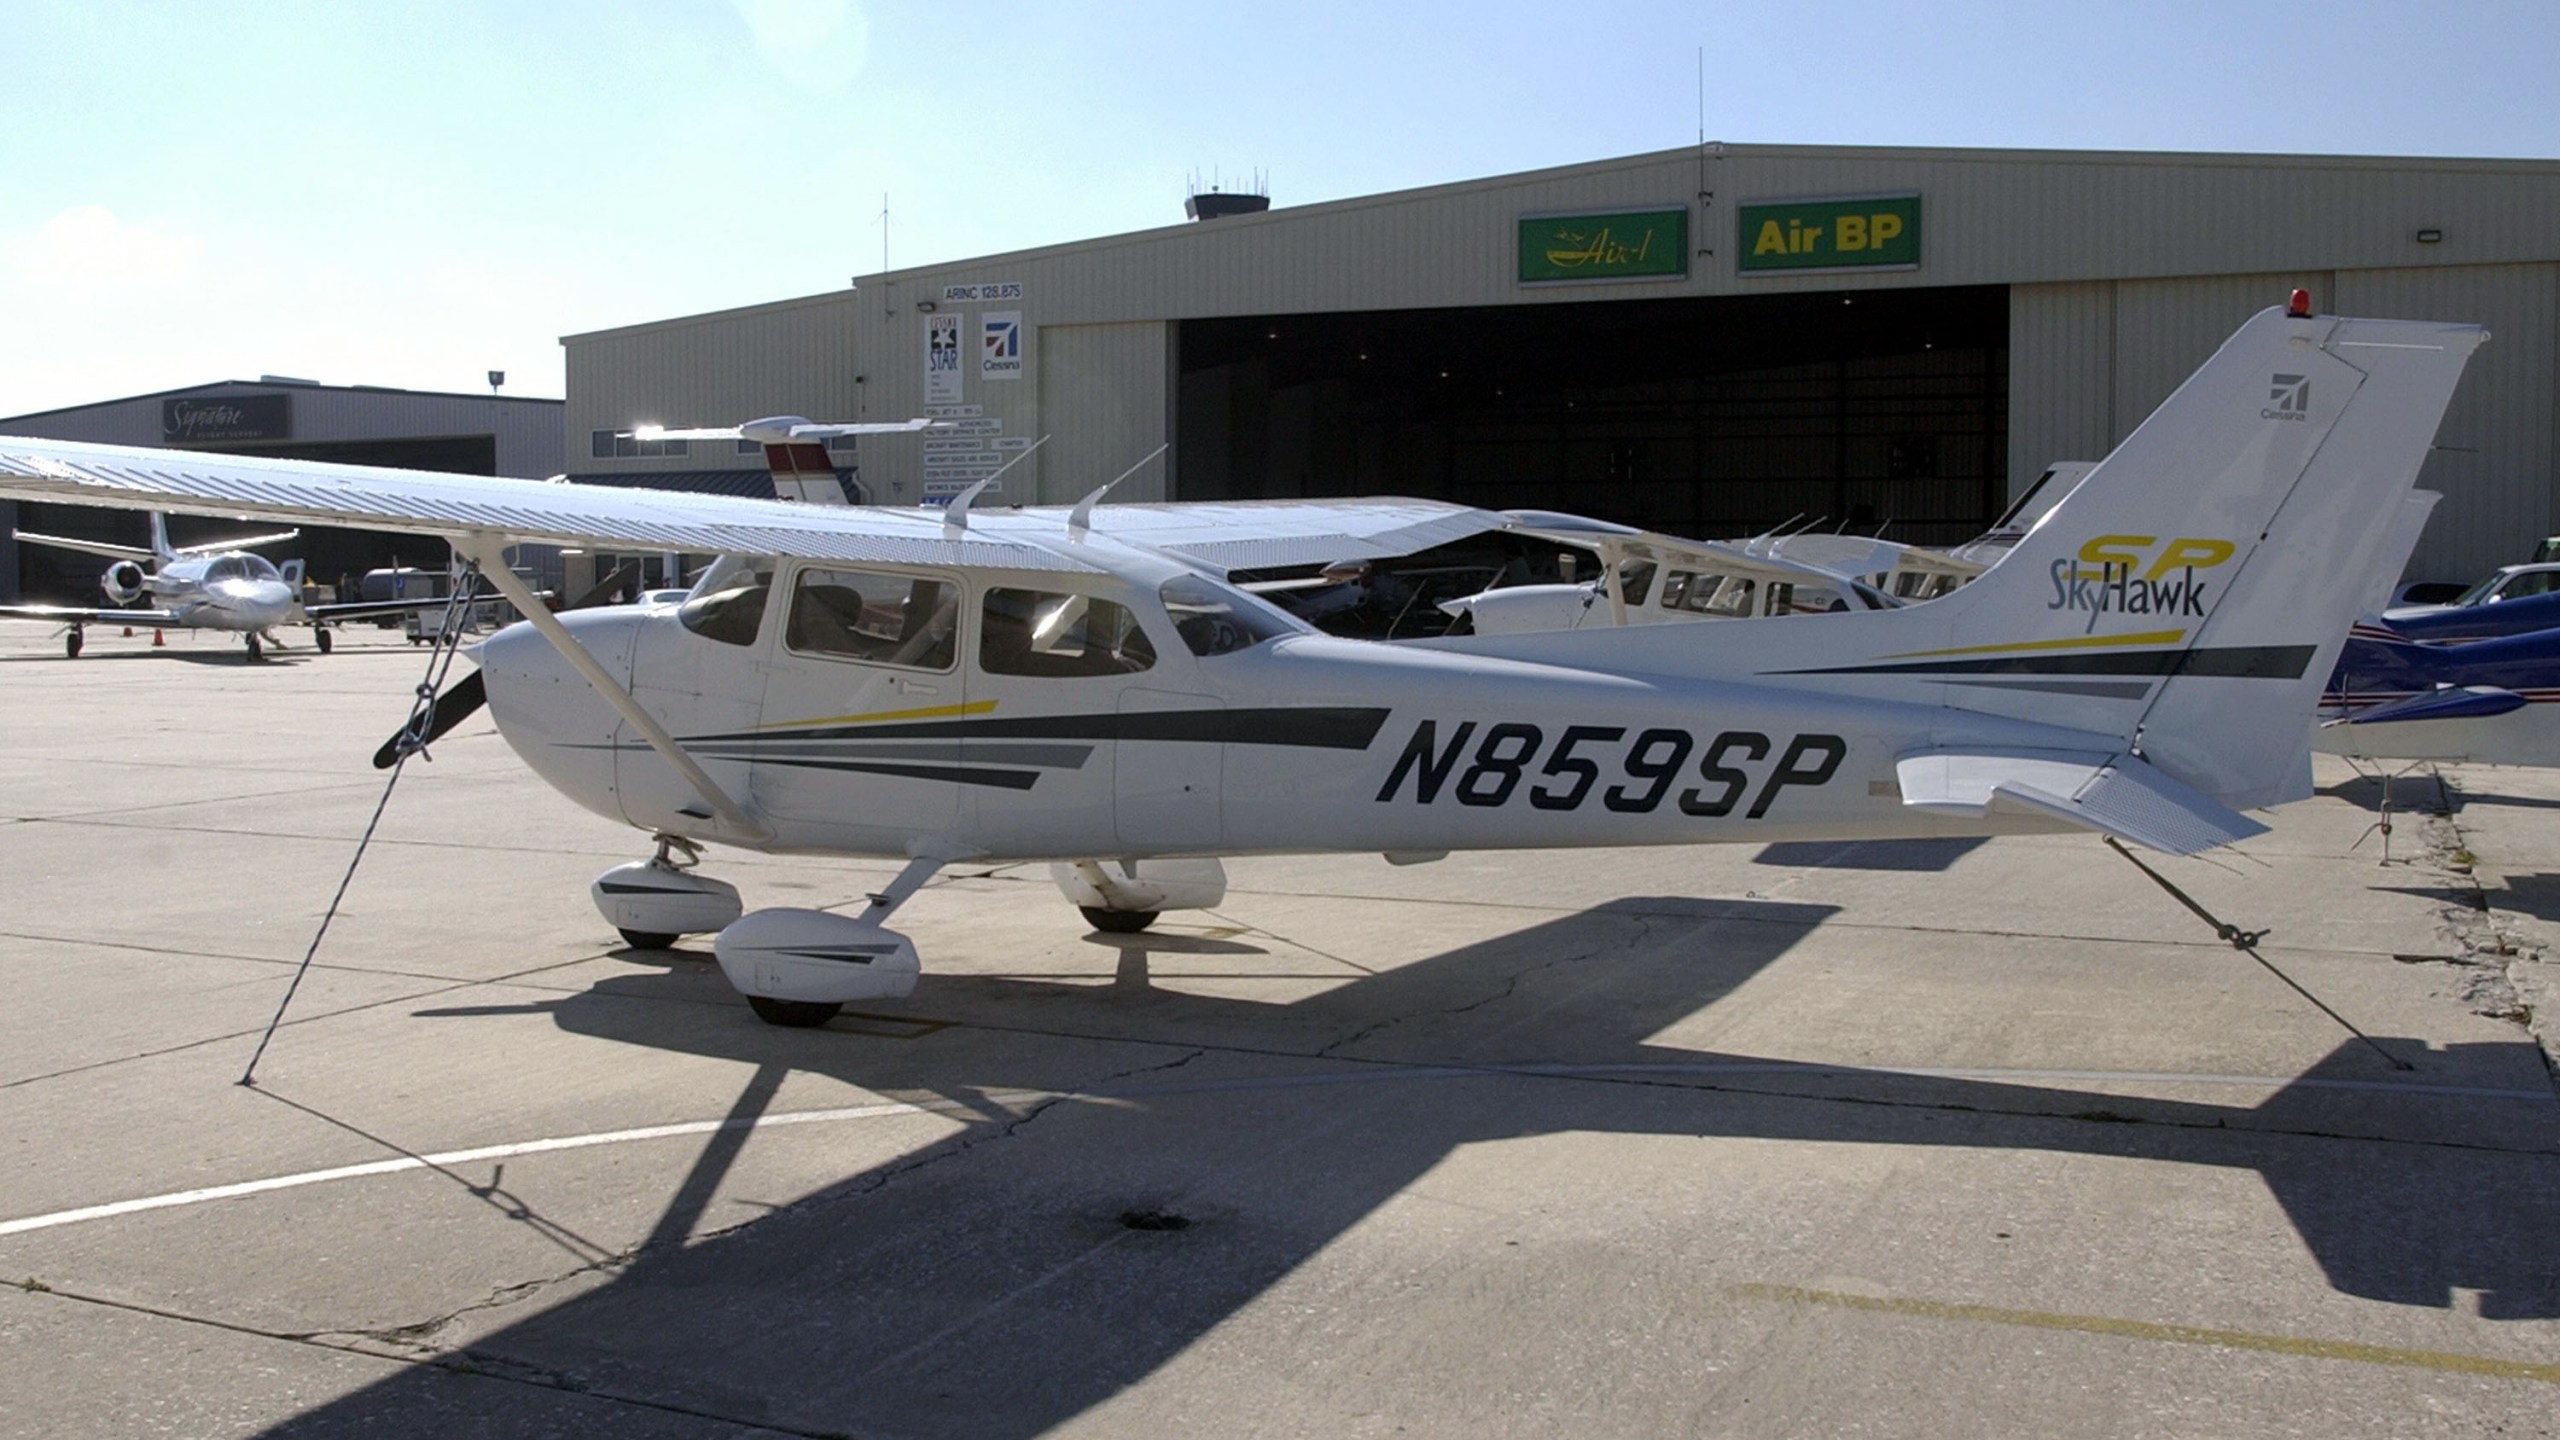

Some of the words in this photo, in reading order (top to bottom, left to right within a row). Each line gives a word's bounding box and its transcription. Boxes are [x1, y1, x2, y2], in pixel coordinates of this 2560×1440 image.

[1753, 219, 1822, 255] Air
[1835, 213, 1903, 252] BP
[945, 286, 978, 300] ARINC
[929, 349, 958, 372] STAR
[983, 360, 1020, 371] Cessna
[164, 401, 242, 437] Signature
[2260, 408, 2306, 421] Cessna
[2062, 534, 2236, 582] SP
[2047, 558, 2206, 634] SkyHawk
[1375, 719, 1847, 820] N859SP
